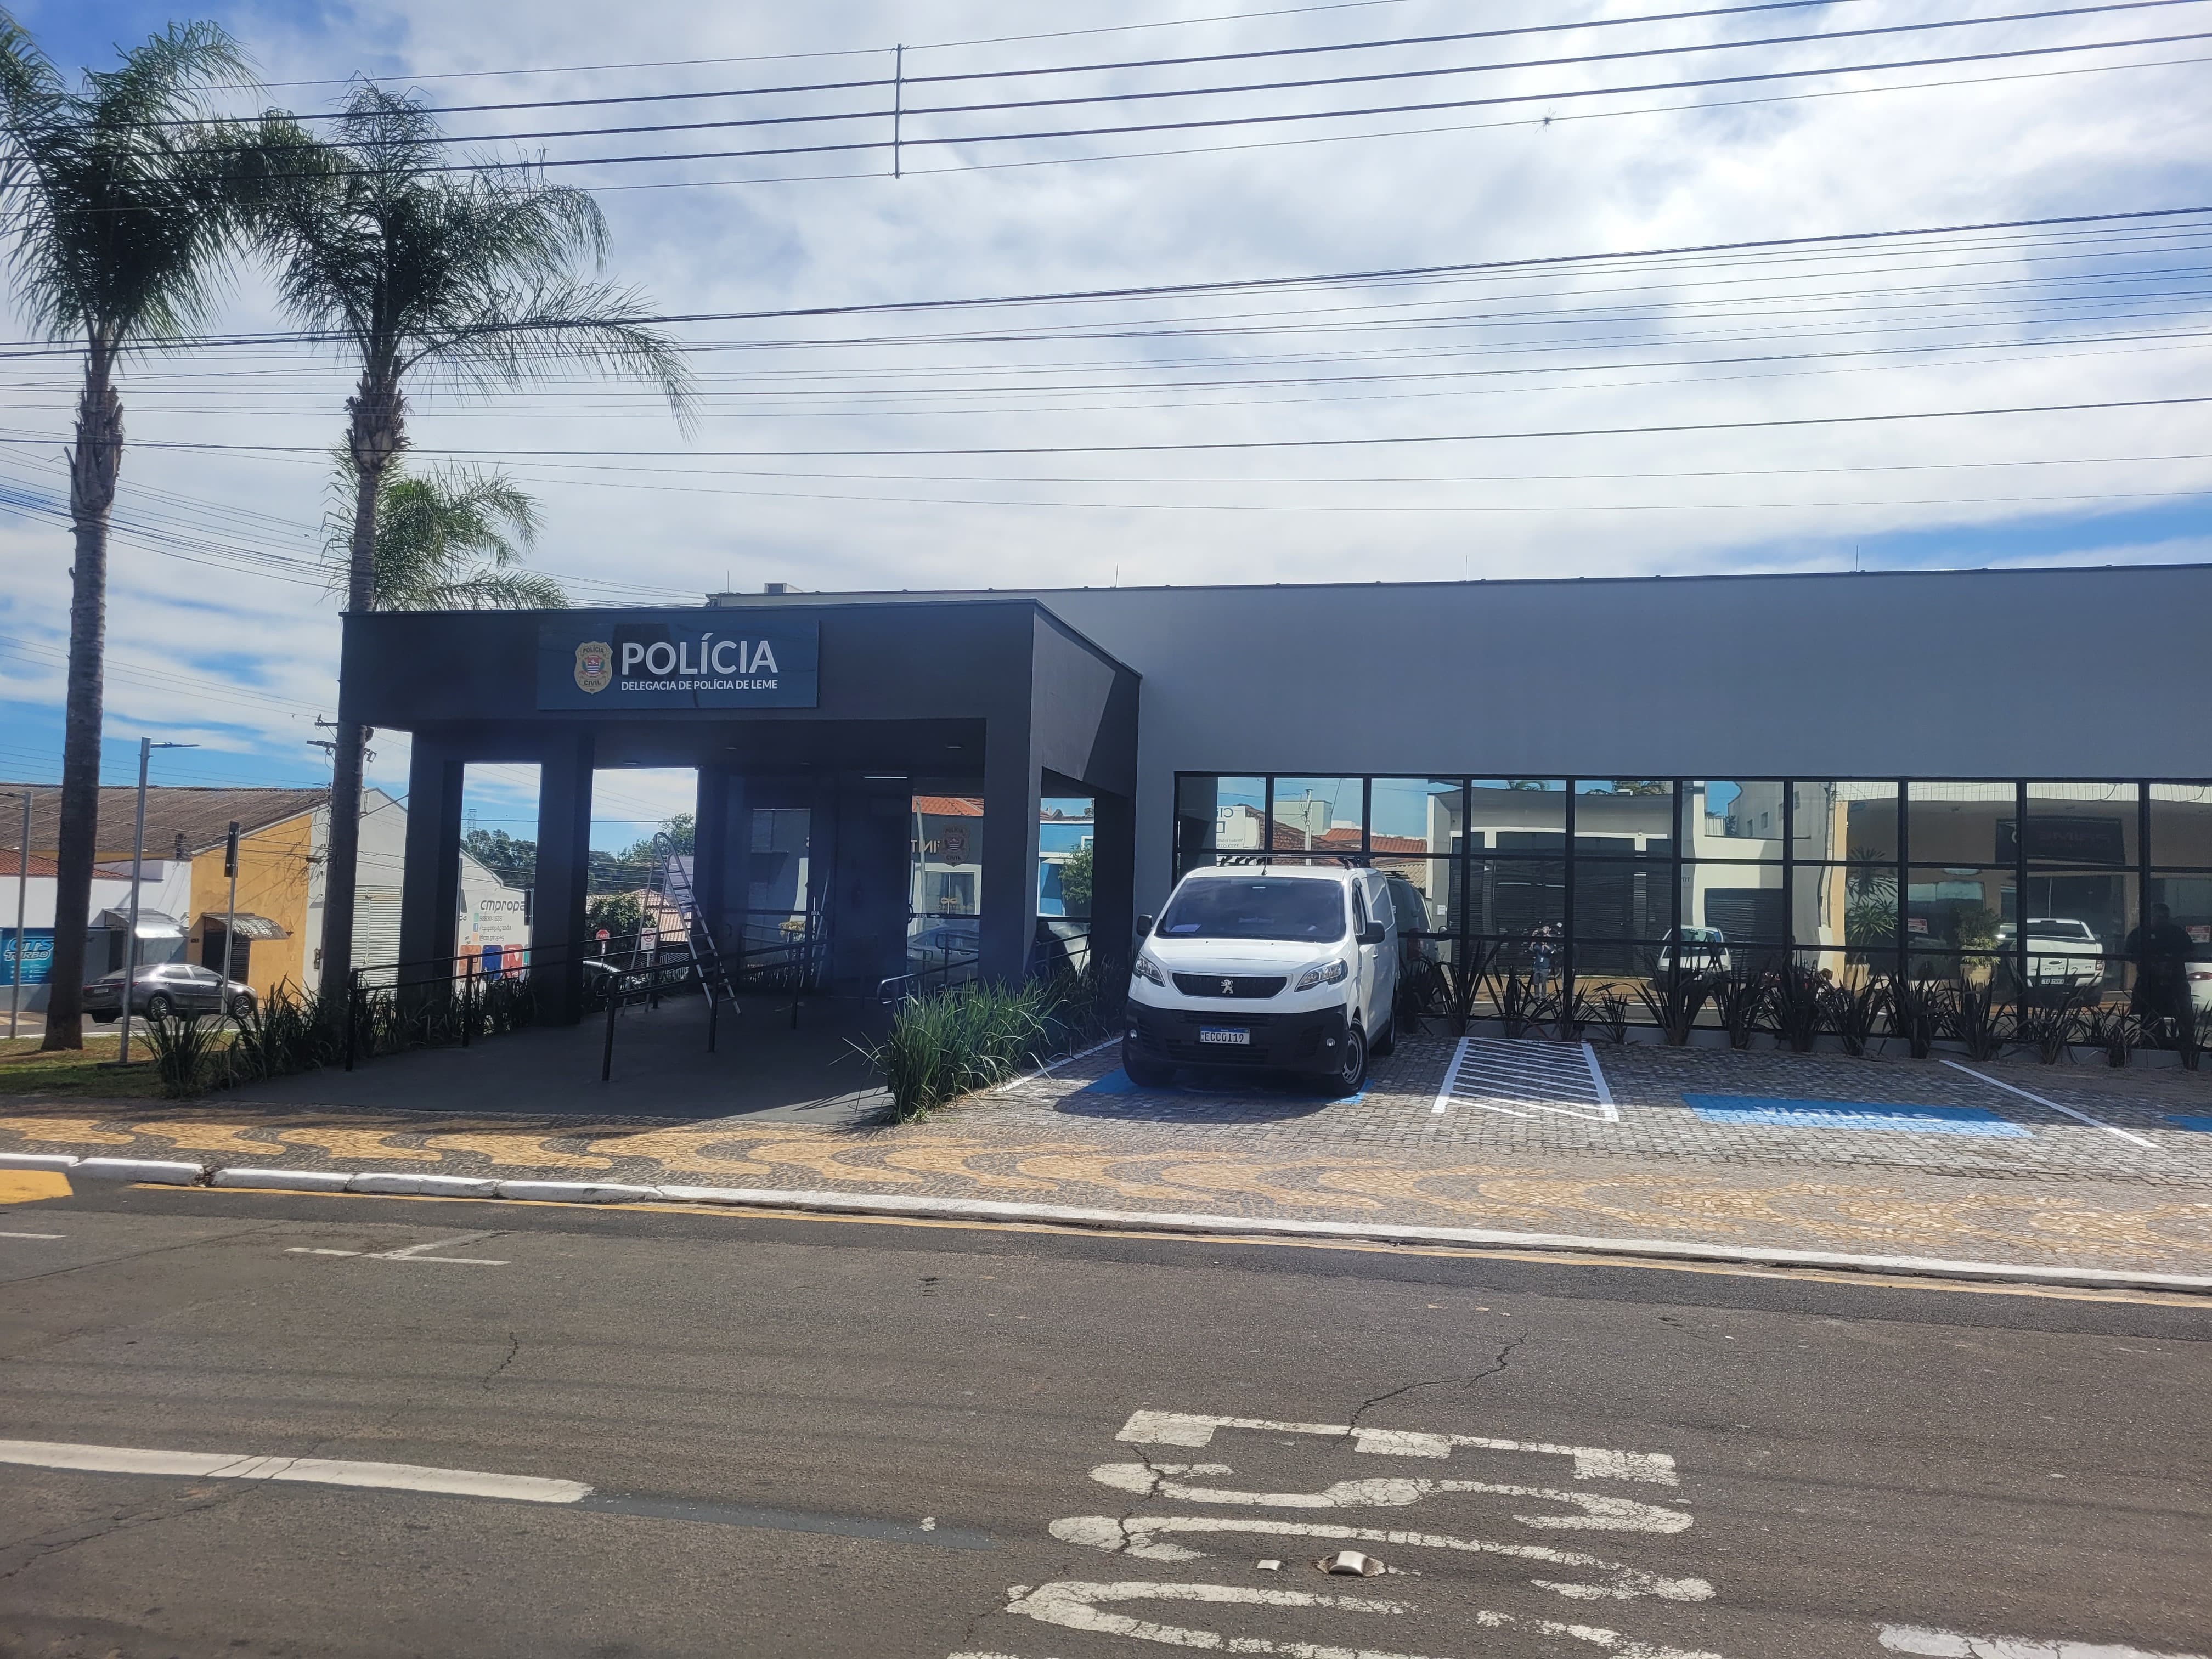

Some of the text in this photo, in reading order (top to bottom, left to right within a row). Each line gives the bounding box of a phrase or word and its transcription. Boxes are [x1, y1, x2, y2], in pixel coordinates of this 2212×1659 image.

[582, 645, 604, 654] POLÍCIA
[622, 633, 778, 675] POLÍCIA
[621, 679, 778, 691] DELEGACIA DE POLÍCIA DE LEME
